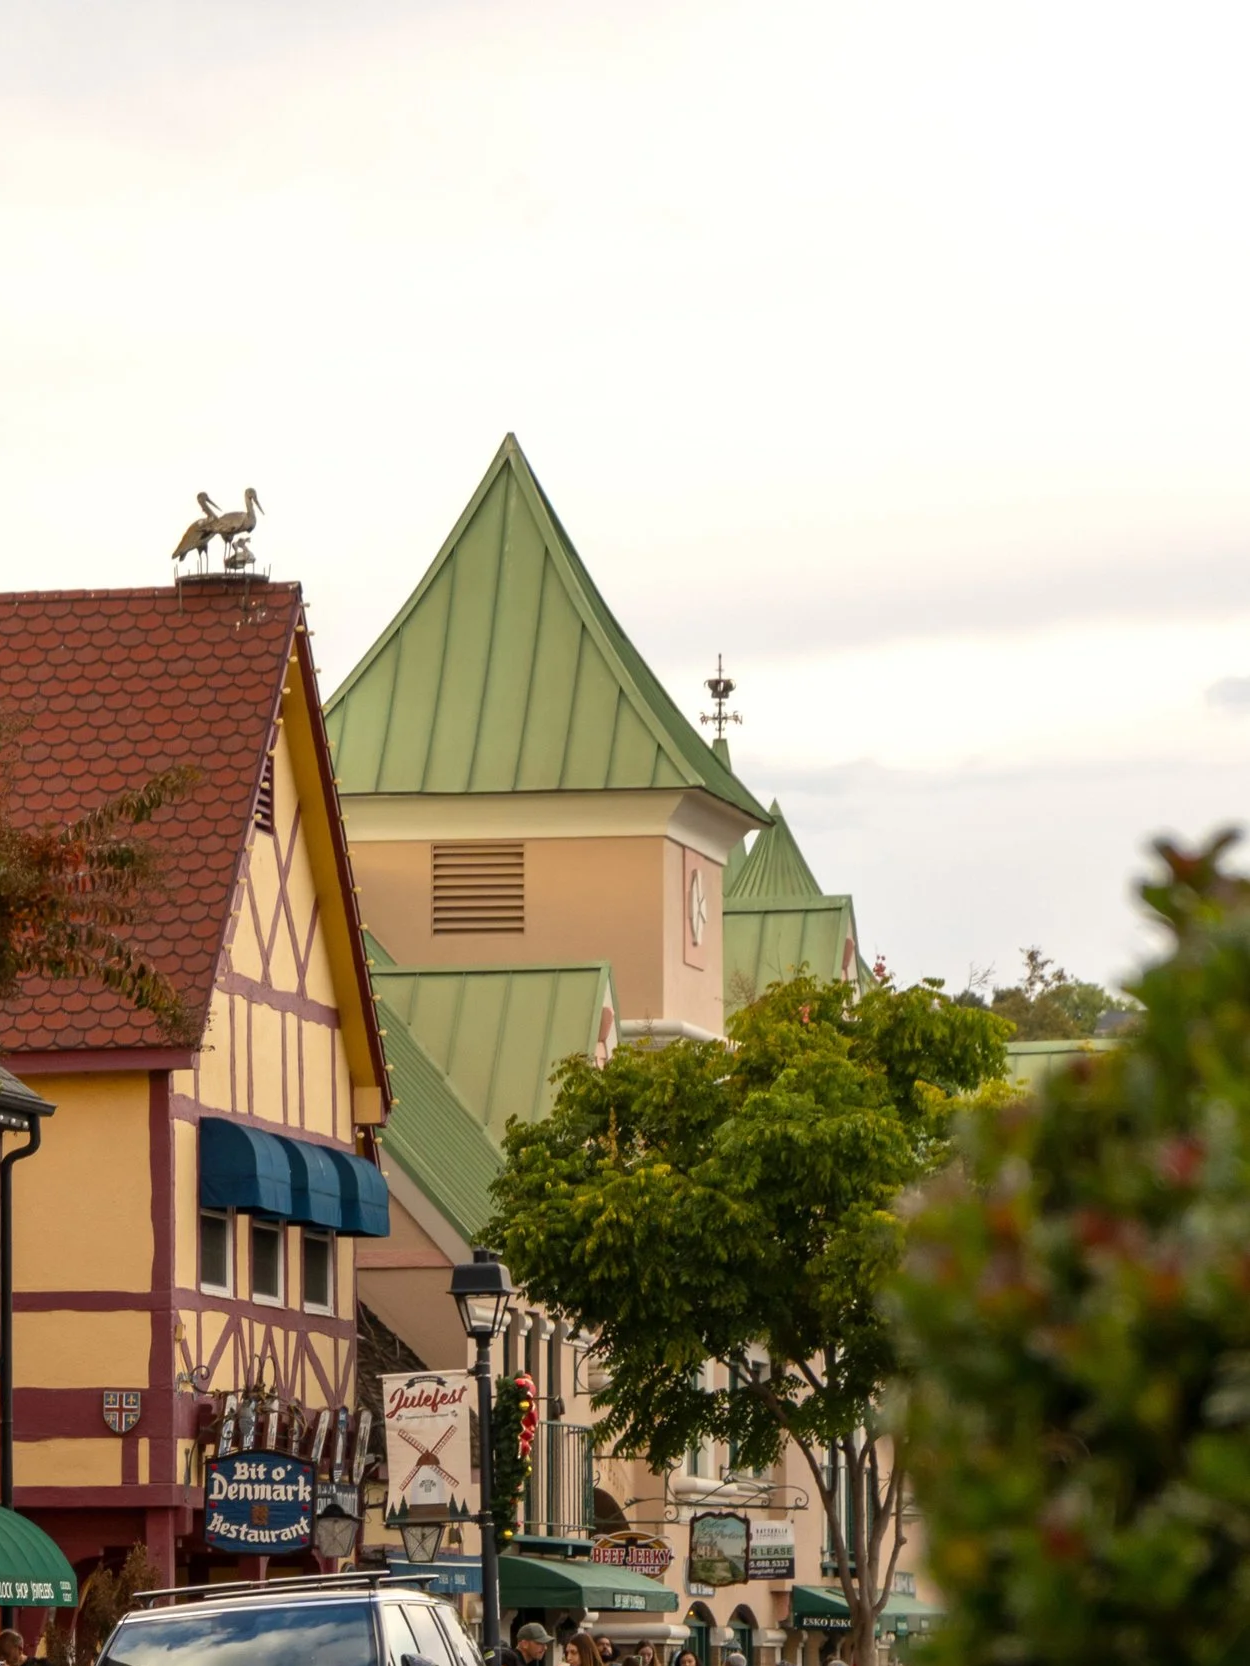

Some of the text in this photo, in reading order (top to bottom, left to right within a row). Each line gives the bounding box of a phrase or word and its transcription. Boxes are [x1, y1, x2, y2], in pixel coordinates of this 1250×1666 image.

[386, 1384, 468, 1419] Julefest
[232, 1461, 293, 1481] Bit o'
[208, 1472, 312, 1502] Denmark
[206, 1512, 311, 1543] Restaurant
[592, 1546, 672, 1565] BEEF JERKY
[761, 1547, 793, 1556] LEASE
[625, 1565, 661, 1575] RIENCE
[750, 1559, 790, 1567] 5.688.5333
[15, 1581, 28, 1599] SHOP
[30, 1580, 54, 1601] JEWELERS
[802, 1617, 828, 1627] ESKO
